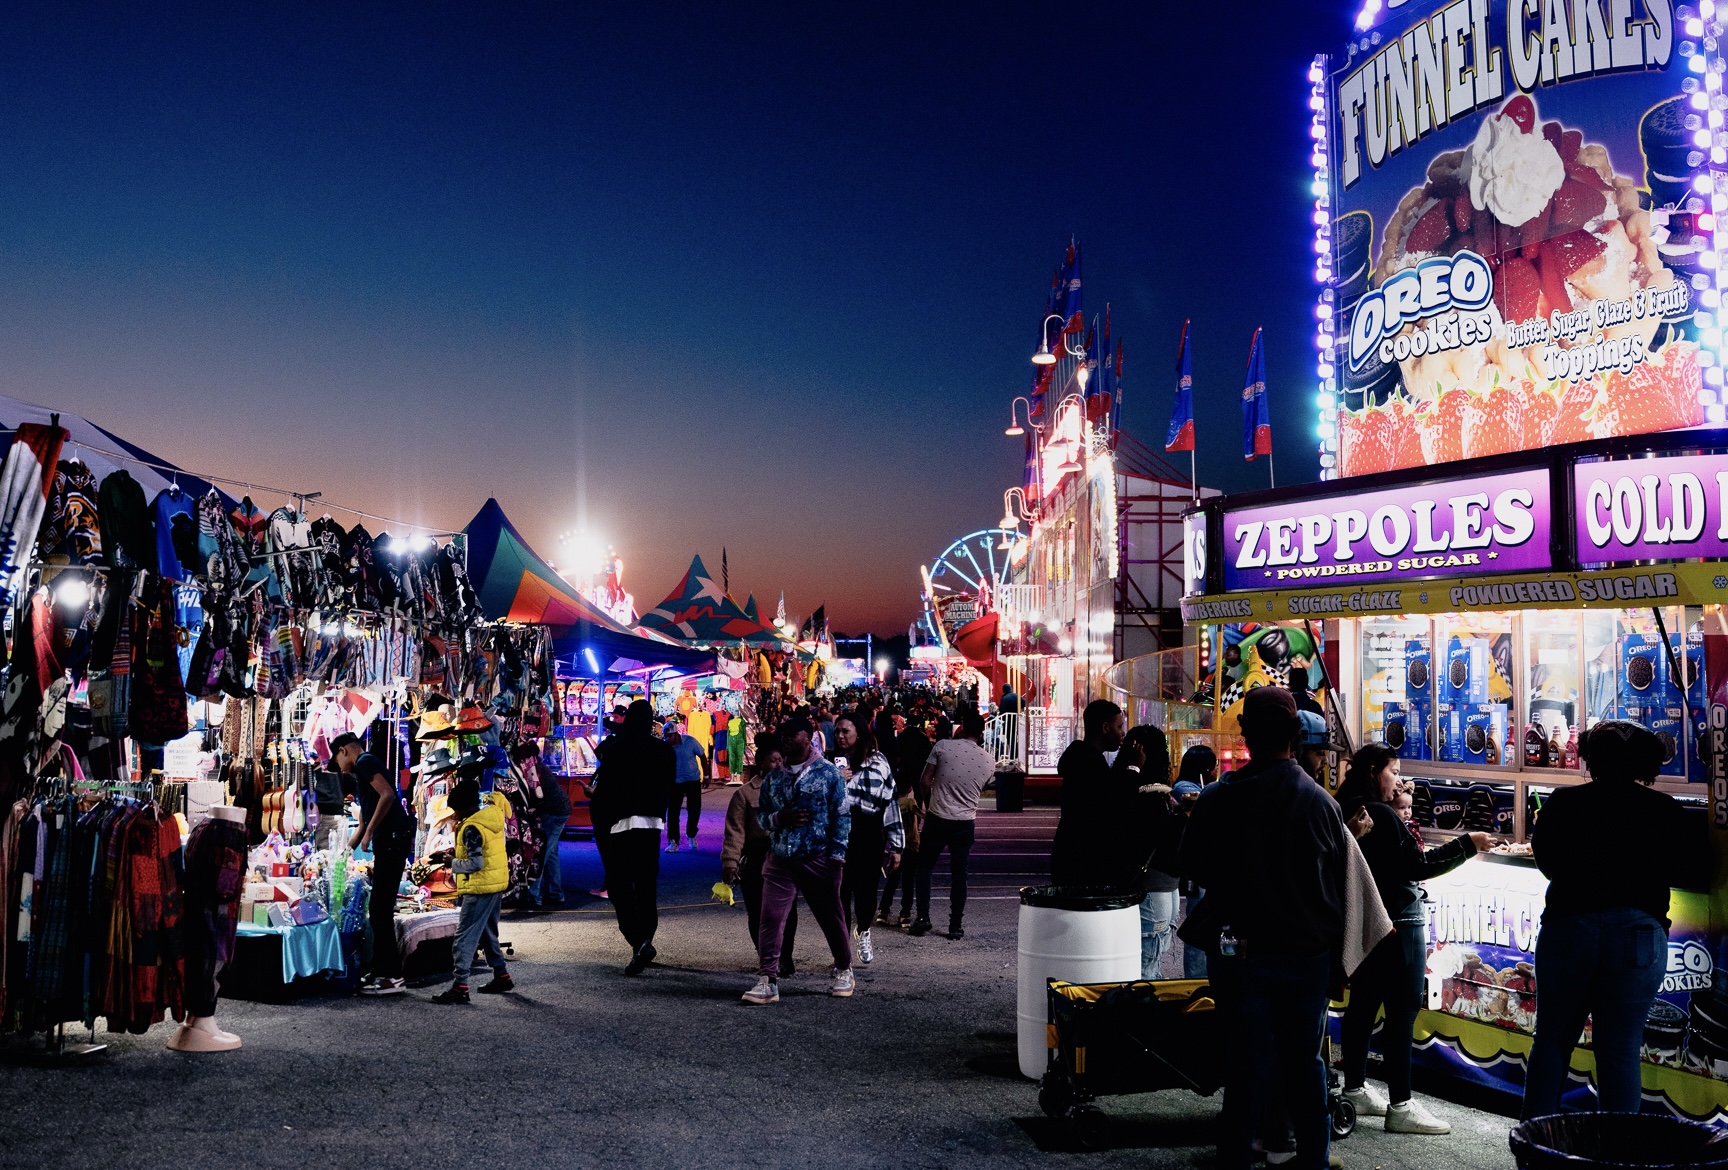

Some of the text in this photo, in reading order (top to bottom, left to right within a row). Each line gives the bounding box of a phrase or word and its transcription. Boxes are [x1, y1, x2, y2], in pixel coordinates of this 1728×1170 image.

[1340, 0, 1673, 188] FUNNEL CAKES
[1351, 252, 1491, 368] OREO
[1506, 319, 1550, 349] Butter,
[1551, 309, 1593, 342] Sugar,
[1595, 299, 1632, 329] Glaze
[1647, 281, 1688, 316] Fruit
[1379, 314, 1492, 364] cookies
[1544, 334, 1644, 384] Toppings
[1235, 488, 1535, 569] ZEPPOLES
[1586, 473, 1706, 547] COLD
[1277, 552, 1481, 580] POWDERED SUGAR
[1288, 590, 1403, 614] SUGAR-GLAZE
[1449, 579, 1576, 607] POWDERED
[1577, 573, 1679, 602] SUGAR
[1629, 644, 1652, 655] OREO
[1652, 719, 1675, 728] OREO
[1433, 804, 1461, 815] OREO
[1424, 893, 1511, 948] FUNNEL
